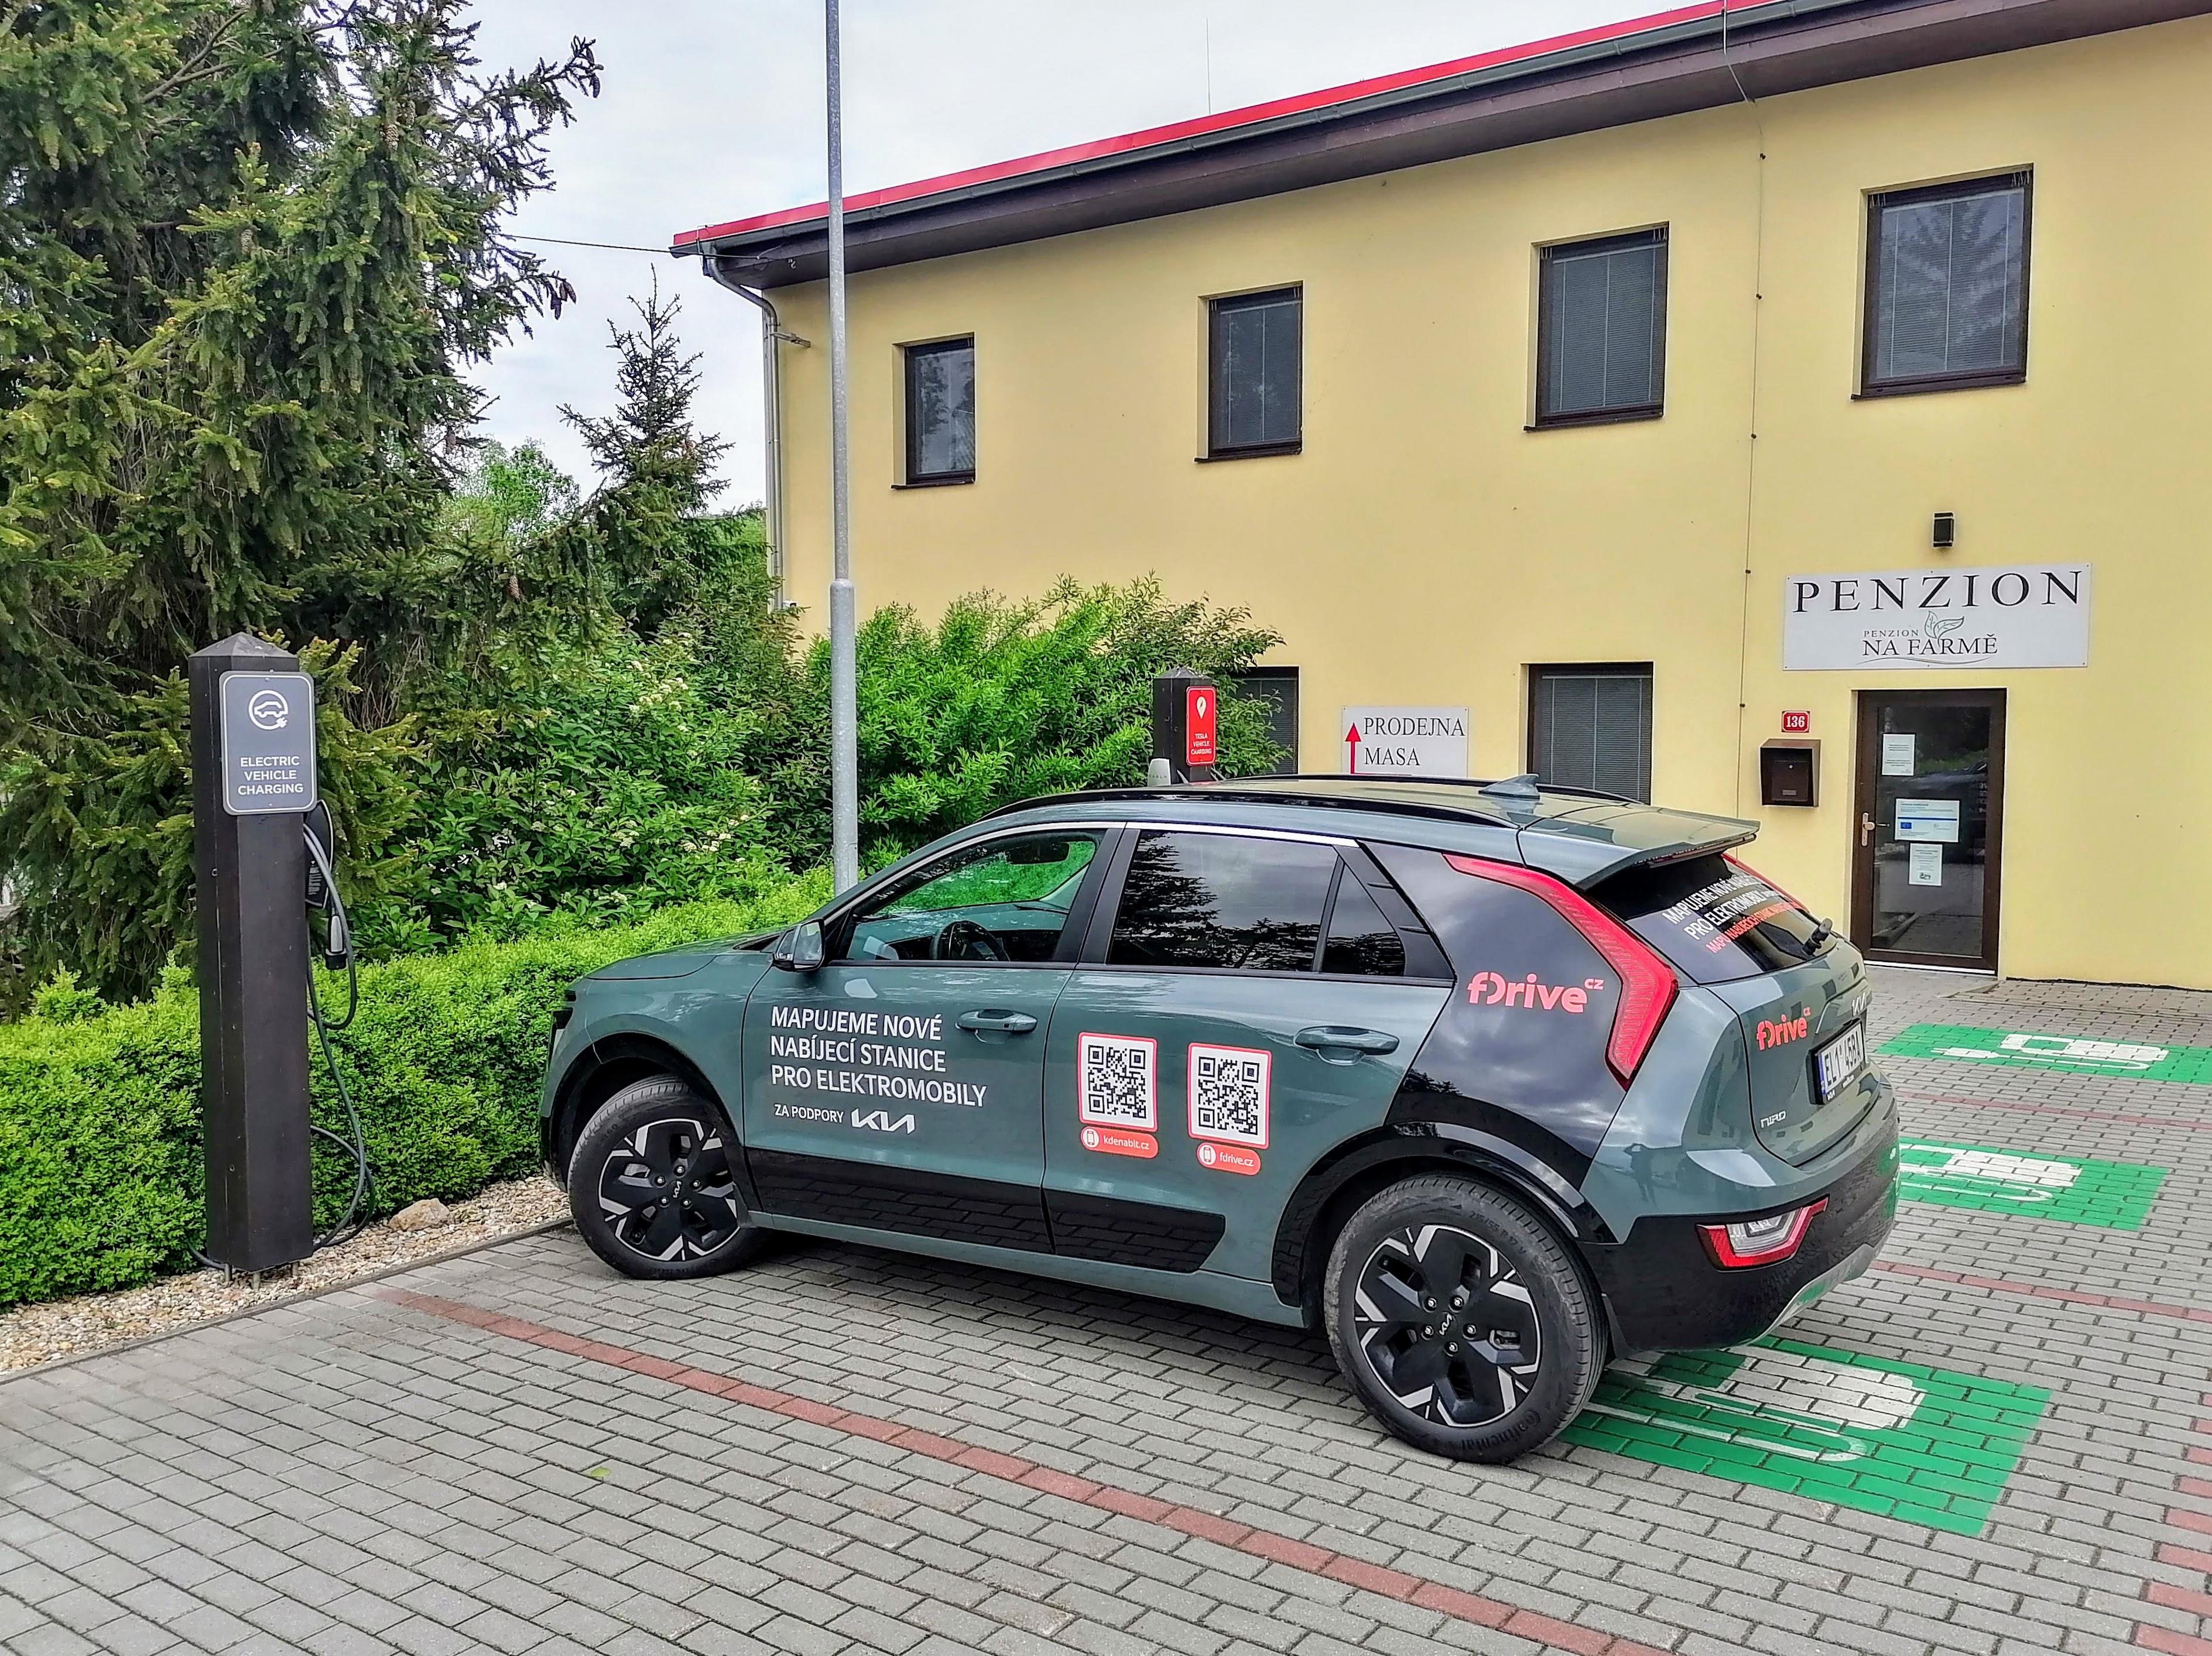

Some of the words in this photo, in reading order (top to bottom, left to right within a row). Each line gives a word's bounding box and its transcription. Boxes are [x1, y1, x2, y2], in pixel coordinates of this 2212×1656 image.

[1792, 571, 2083, 613] PENZION
[1864, 629, 1919, 637] PENZION
[1862, 639, 1900, 656] NA
[1907, 633, 1998, 655] FARMĚ
[1364, 717, 1465, 736] PRODEJNA
[1786, 715, 1805, 728] 136
[240, 756, 300, 767] ELECTRIC
[1364, 747, 1421, 766] MASA
[244, 770, 297, 781] VEHICLE
[238, 783, 303, 796] CHARGING
[1662, 886, 1719, 924] MAPUJEME
[1683, 918, 1714, 940] PRO
[1704, 890, 1768, 926] ELEKTROMOBILY
[771, 1006, 878, 1036] MAPUJEME
[883, 1013, 943, 1041] NOVÉ
[771, 1034, 857, 1064] NABÍJECÍ
[860, 1043, 946, 1073] STANICE
[771, 1064, 811, 1088] PRO
[817, 1068, 988, 1108] ELEKTROMOBILY
[774, 1103, 790, 1117] ZA
[792, 1105, 844, 1124] PODPORY
[851, 1108, 915, 1135] KIA
[1220, 1151, 1255, 1167] fdrive.cz
